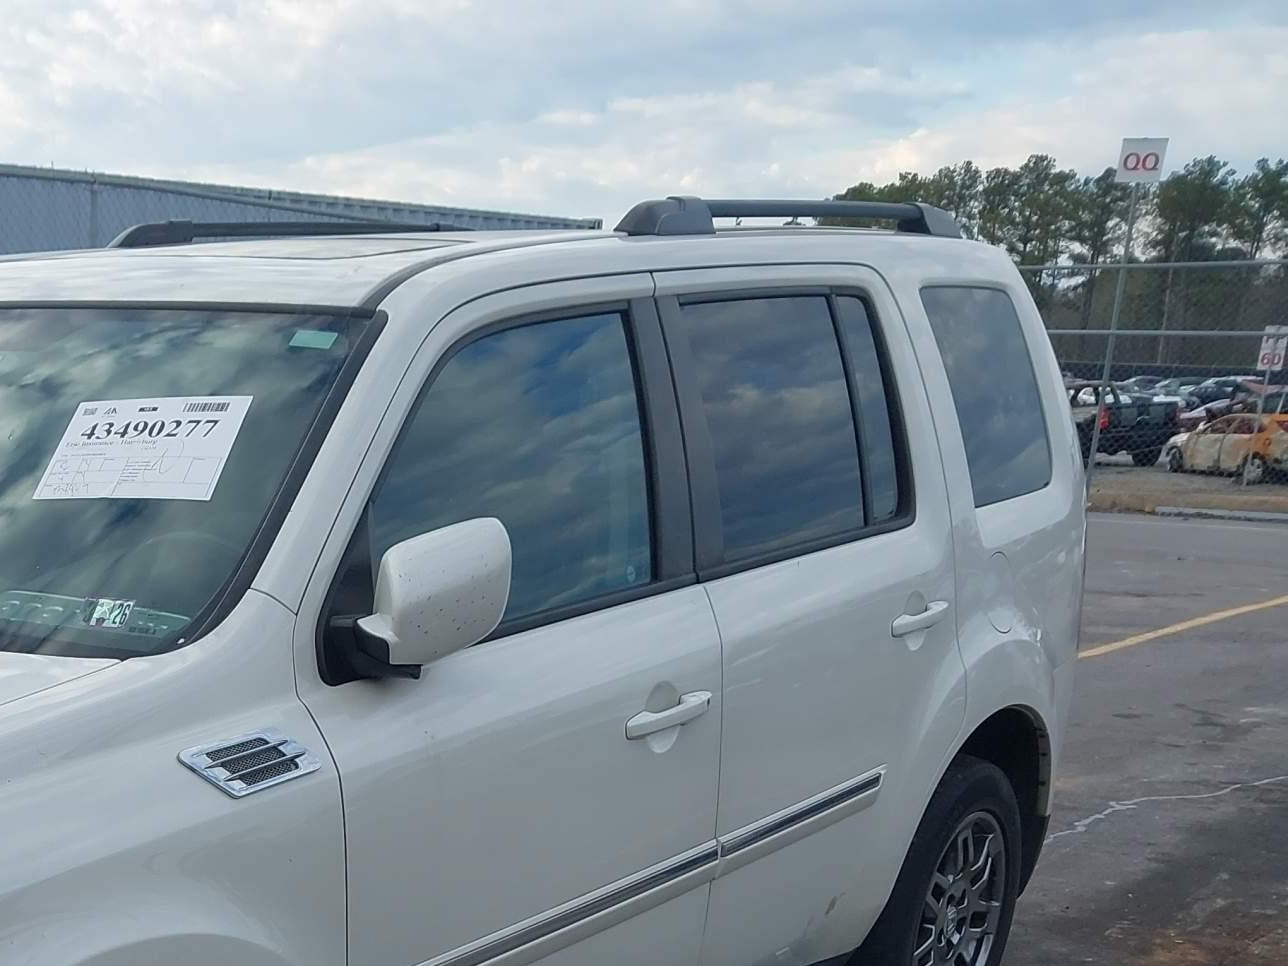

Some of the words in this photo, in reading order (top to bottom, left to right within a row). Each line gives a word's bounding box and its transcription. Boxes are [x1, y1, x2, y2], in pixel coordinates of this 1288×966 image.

[1123, 152, 1159, 170] QQ
[1261, 352, 1281, 365] 60
[80, 419, 220, 440] 43490277
[112, 603, 130, 624] 26
